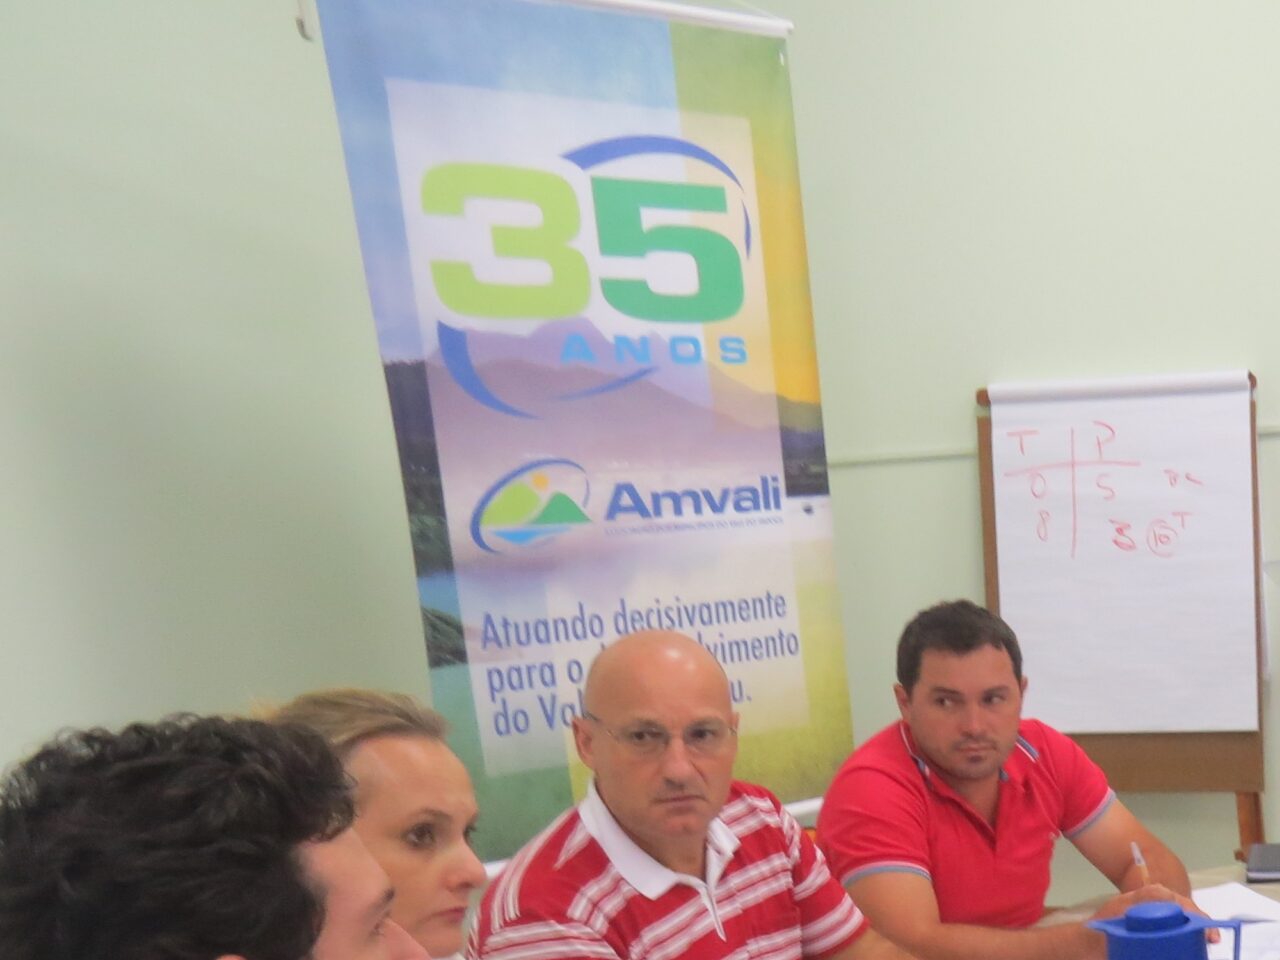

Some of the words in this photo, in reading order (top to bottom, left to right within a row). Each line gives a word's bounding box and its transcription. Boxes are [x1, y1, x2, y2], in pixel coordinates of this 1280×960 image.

[421, 161, 745, 323] 35
[560, 334, 748, 365] ANOS
[1007, 430, 1039, 456] T
[605, 476, 782, 521] Amvali
[481, 602, 604, 649] Atuando
[613, 591, 787, 635] decisivamente
[486, 660, 556, 703] para
[567, 658, 583, 685] o
[493, 697, 530, 736] do
